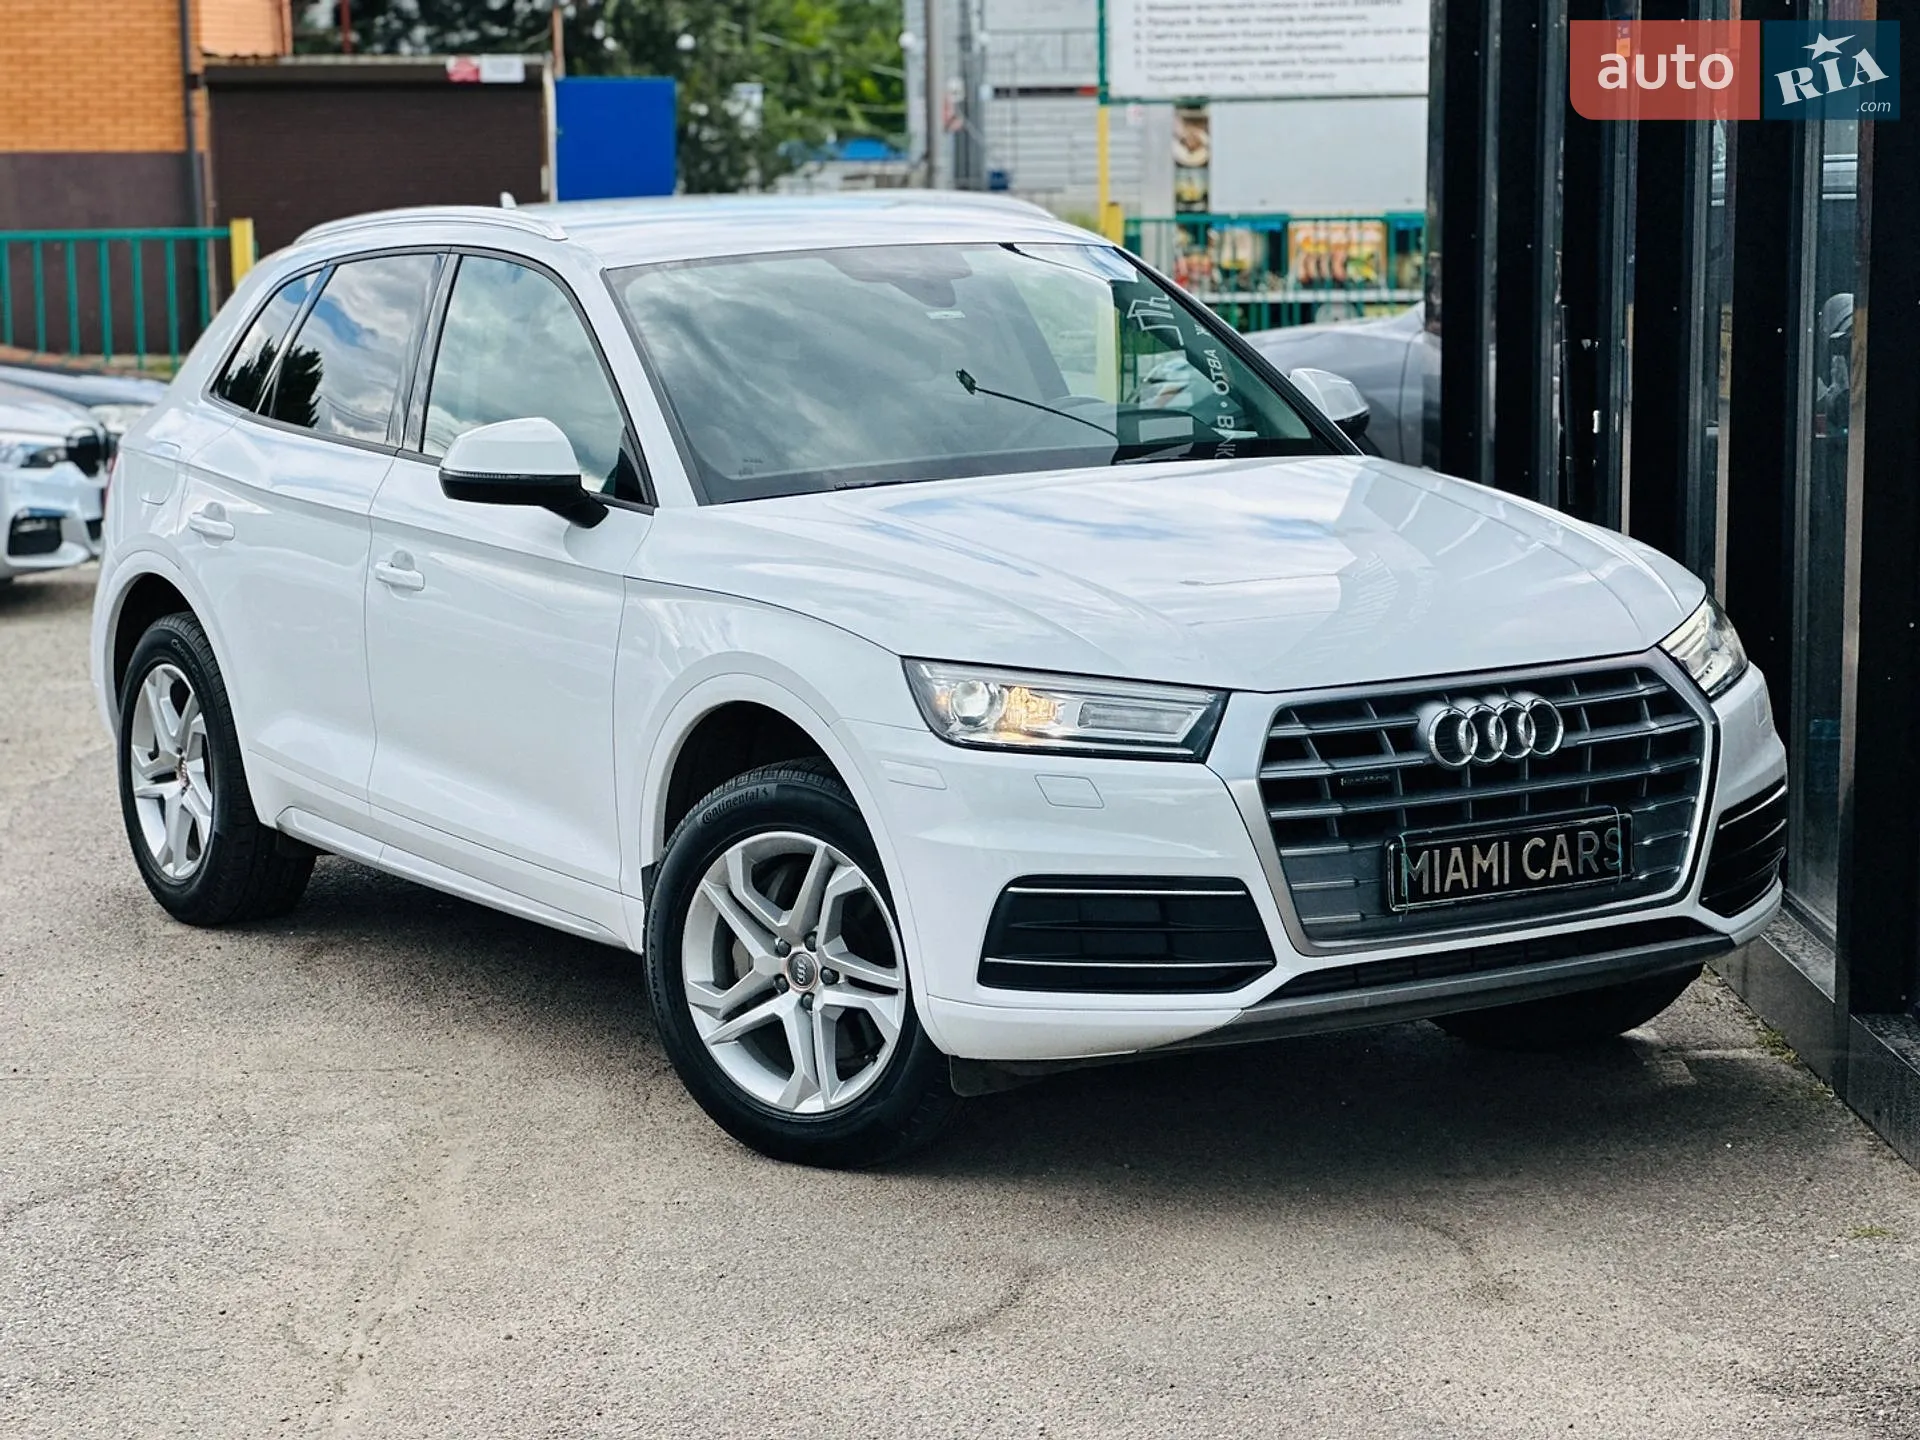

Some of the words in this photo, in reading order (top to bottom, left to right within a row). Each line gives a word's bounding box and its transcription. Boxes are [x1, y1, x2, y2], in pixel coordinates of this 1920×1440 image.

[702, 787, 760, 825] Continental
[1401, 841, 1510, 897] MIAMI
[1522, 827, 1622, 881] CARS
